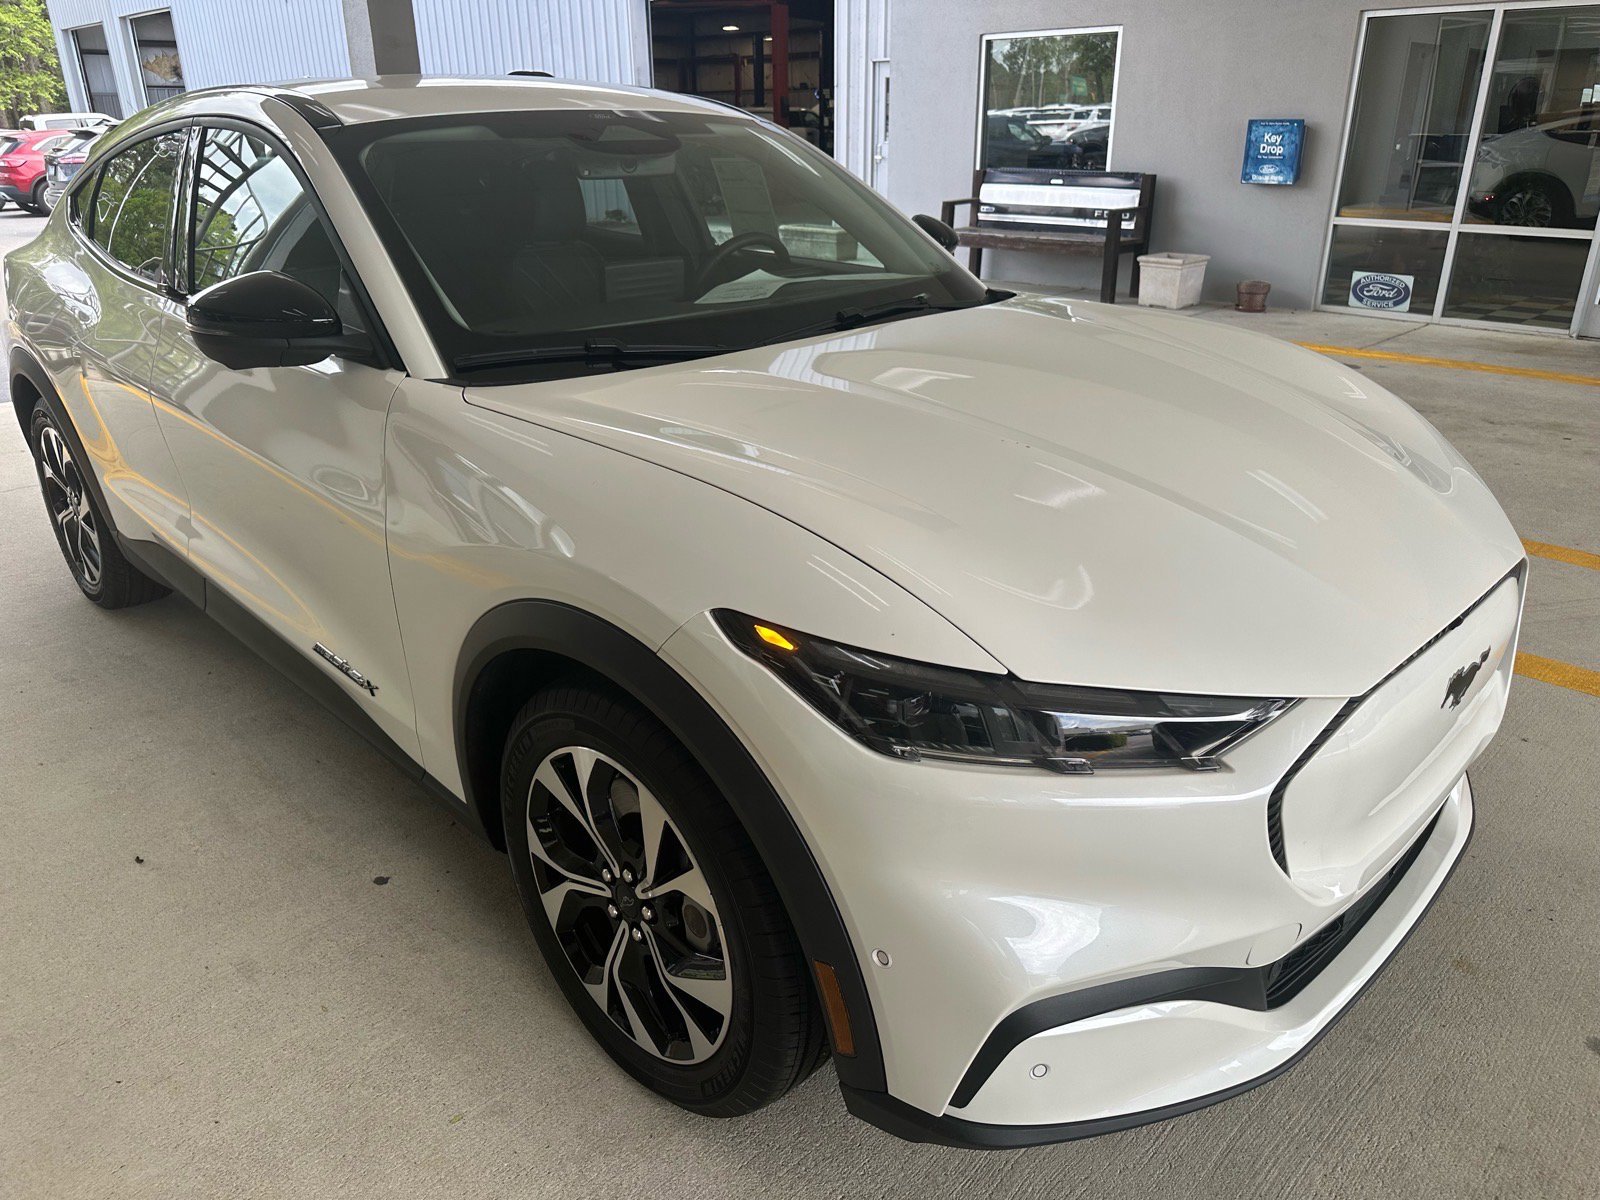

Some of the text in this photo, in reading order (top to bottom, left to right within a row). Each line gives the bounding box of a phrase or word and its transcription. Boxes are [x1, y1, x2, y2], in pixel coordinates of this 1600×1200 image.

[1264, 132, 1283, 145] Key
[1259, 143, 1284, 156] Drop
[1360, 275, 1406, 288] AUTHORIZED
[1363, 283, 1398, 298] Ford
[1362, 299, 1394, 309] SERVICE
